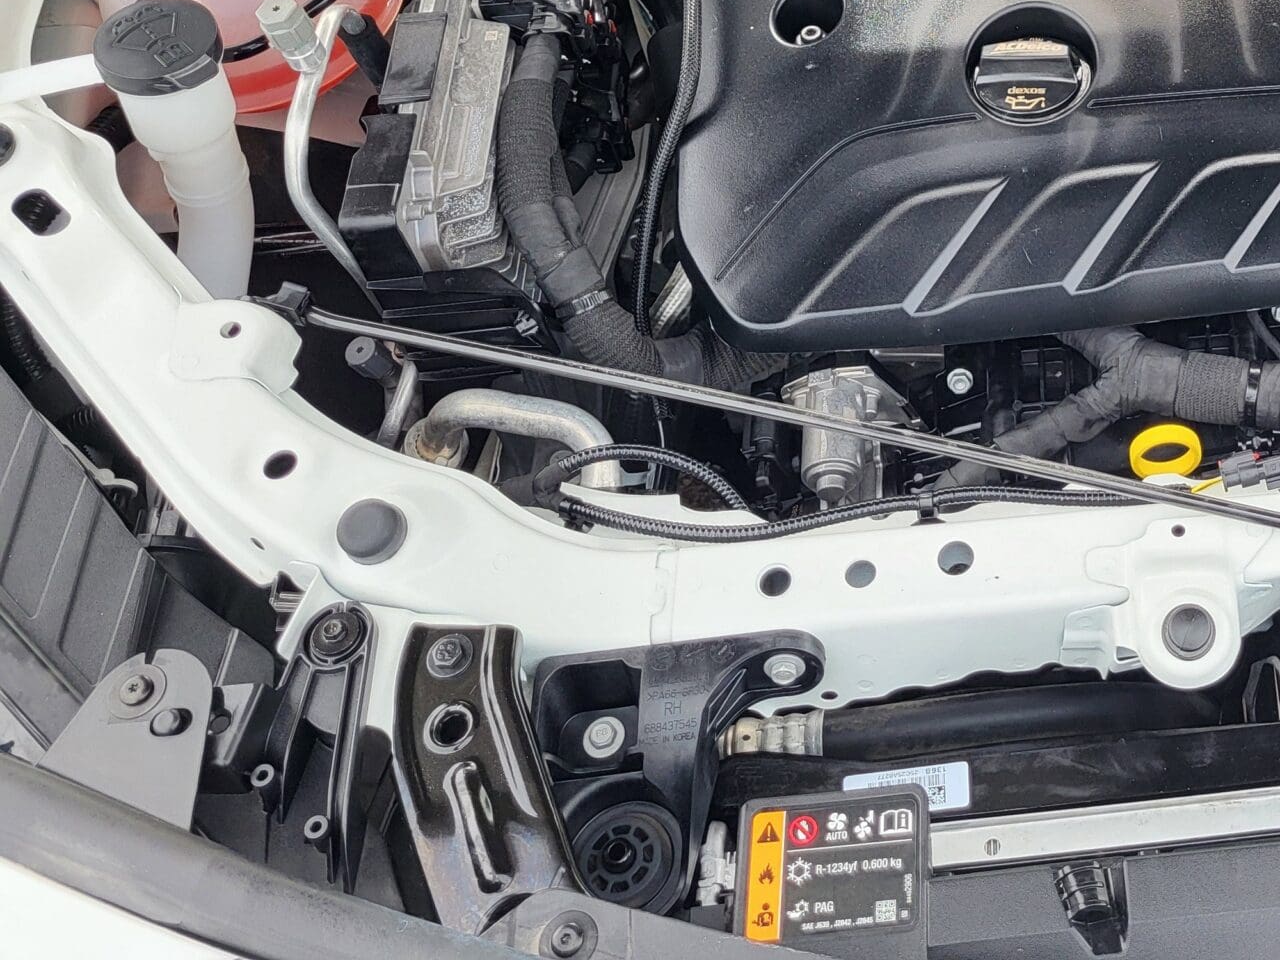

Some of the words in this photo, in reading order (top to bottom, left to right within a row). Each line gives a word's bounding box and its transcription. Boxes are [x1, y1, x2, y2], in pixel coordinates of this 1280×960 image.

[1007, 85, 1047, 95] dexos
[664, 700, 682, 717] RH
[672, 731, 696, 742] KOREA
[825, 831, 848, 841] AUTO
[815, 859, 858, 875] R-1234yf
[862, 858, 888, 871] 0.600
[890, 856, 902, 870] kg
[814, 901, 834, 914] PAG
[802, 922, 814, 930] SAE
